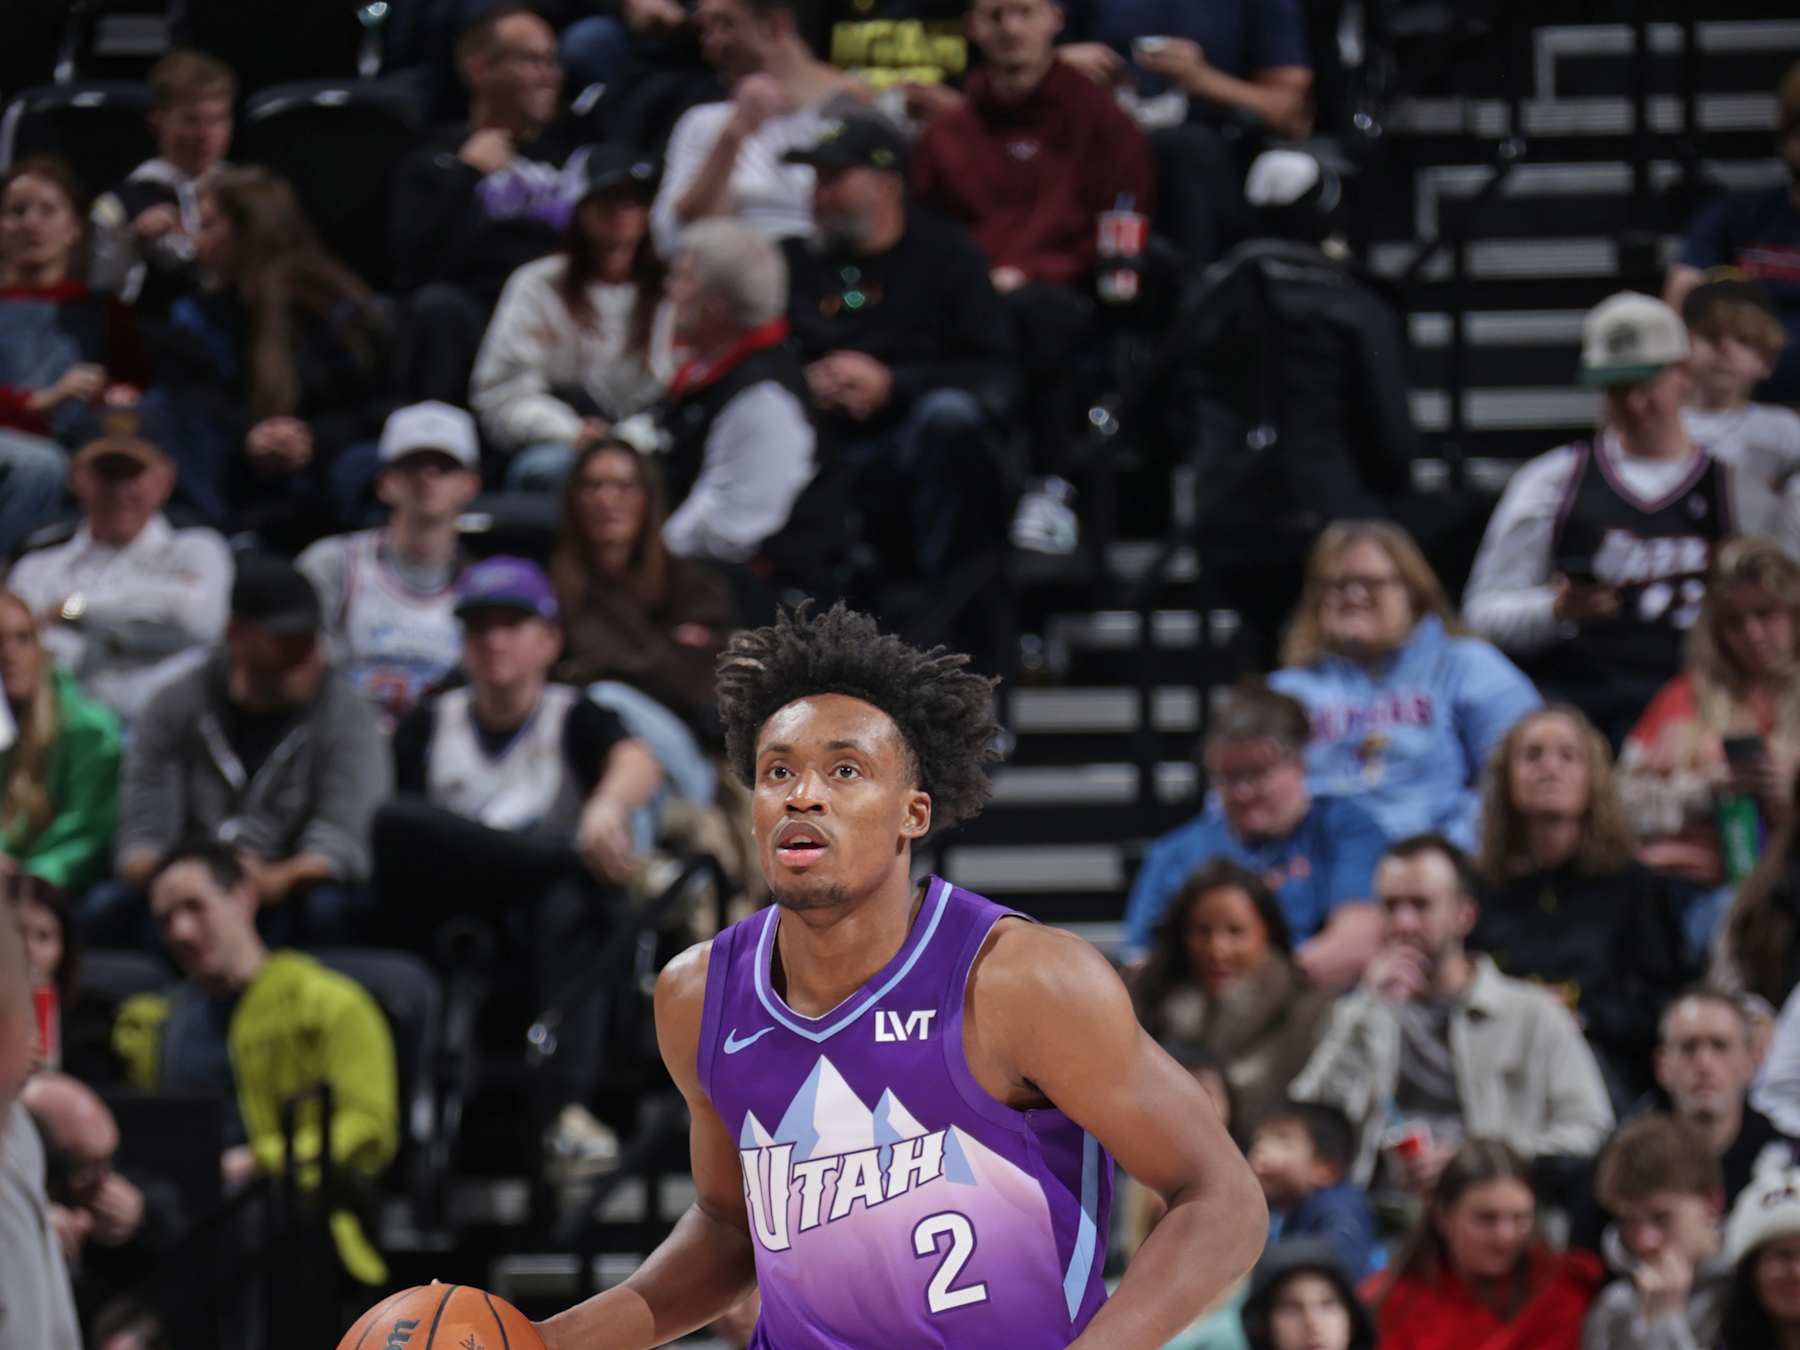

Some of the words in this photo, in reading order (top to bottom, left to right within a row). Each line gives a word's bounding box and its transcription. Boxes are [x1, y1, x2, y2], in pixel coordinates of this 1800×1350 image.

[875, 1009, 937, 1042] LVT
[740, 1129, 947, 1253] UTAH
[912, 1210, 990, 1315] 2
